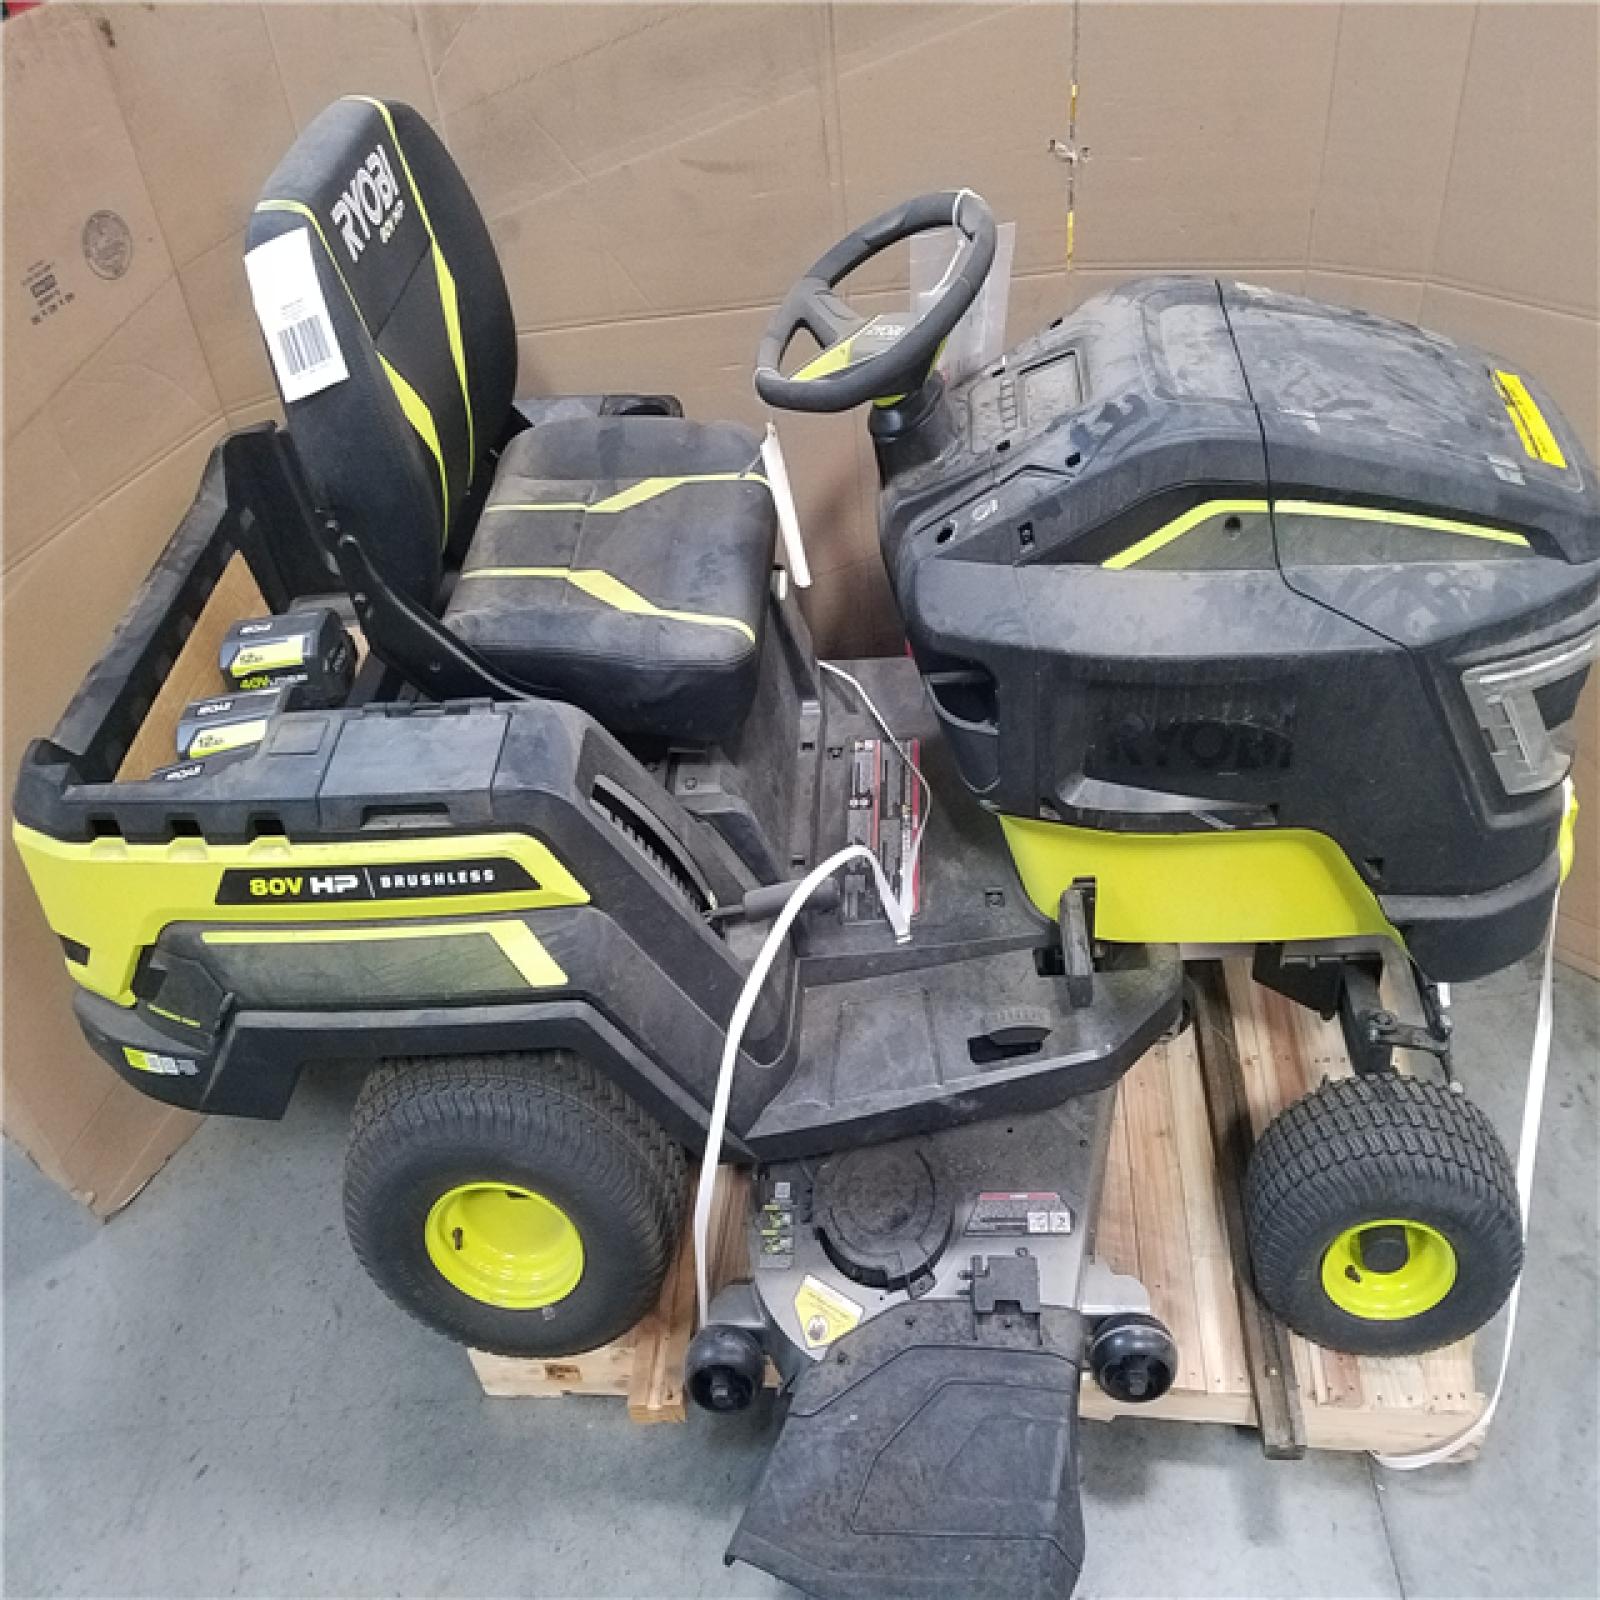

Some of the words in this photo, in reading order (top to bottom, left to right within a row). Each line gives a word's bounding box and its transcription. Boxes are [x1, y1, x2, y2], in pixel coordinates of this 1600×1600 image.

[331, 144, 399, 263] RYOBI
[239, 674, 269, 690] 40V
[250, 876, 303, 896] 80V
[309, 873, 359, 894] HP
[379, 868, 497, 889] BRUSHLESS
